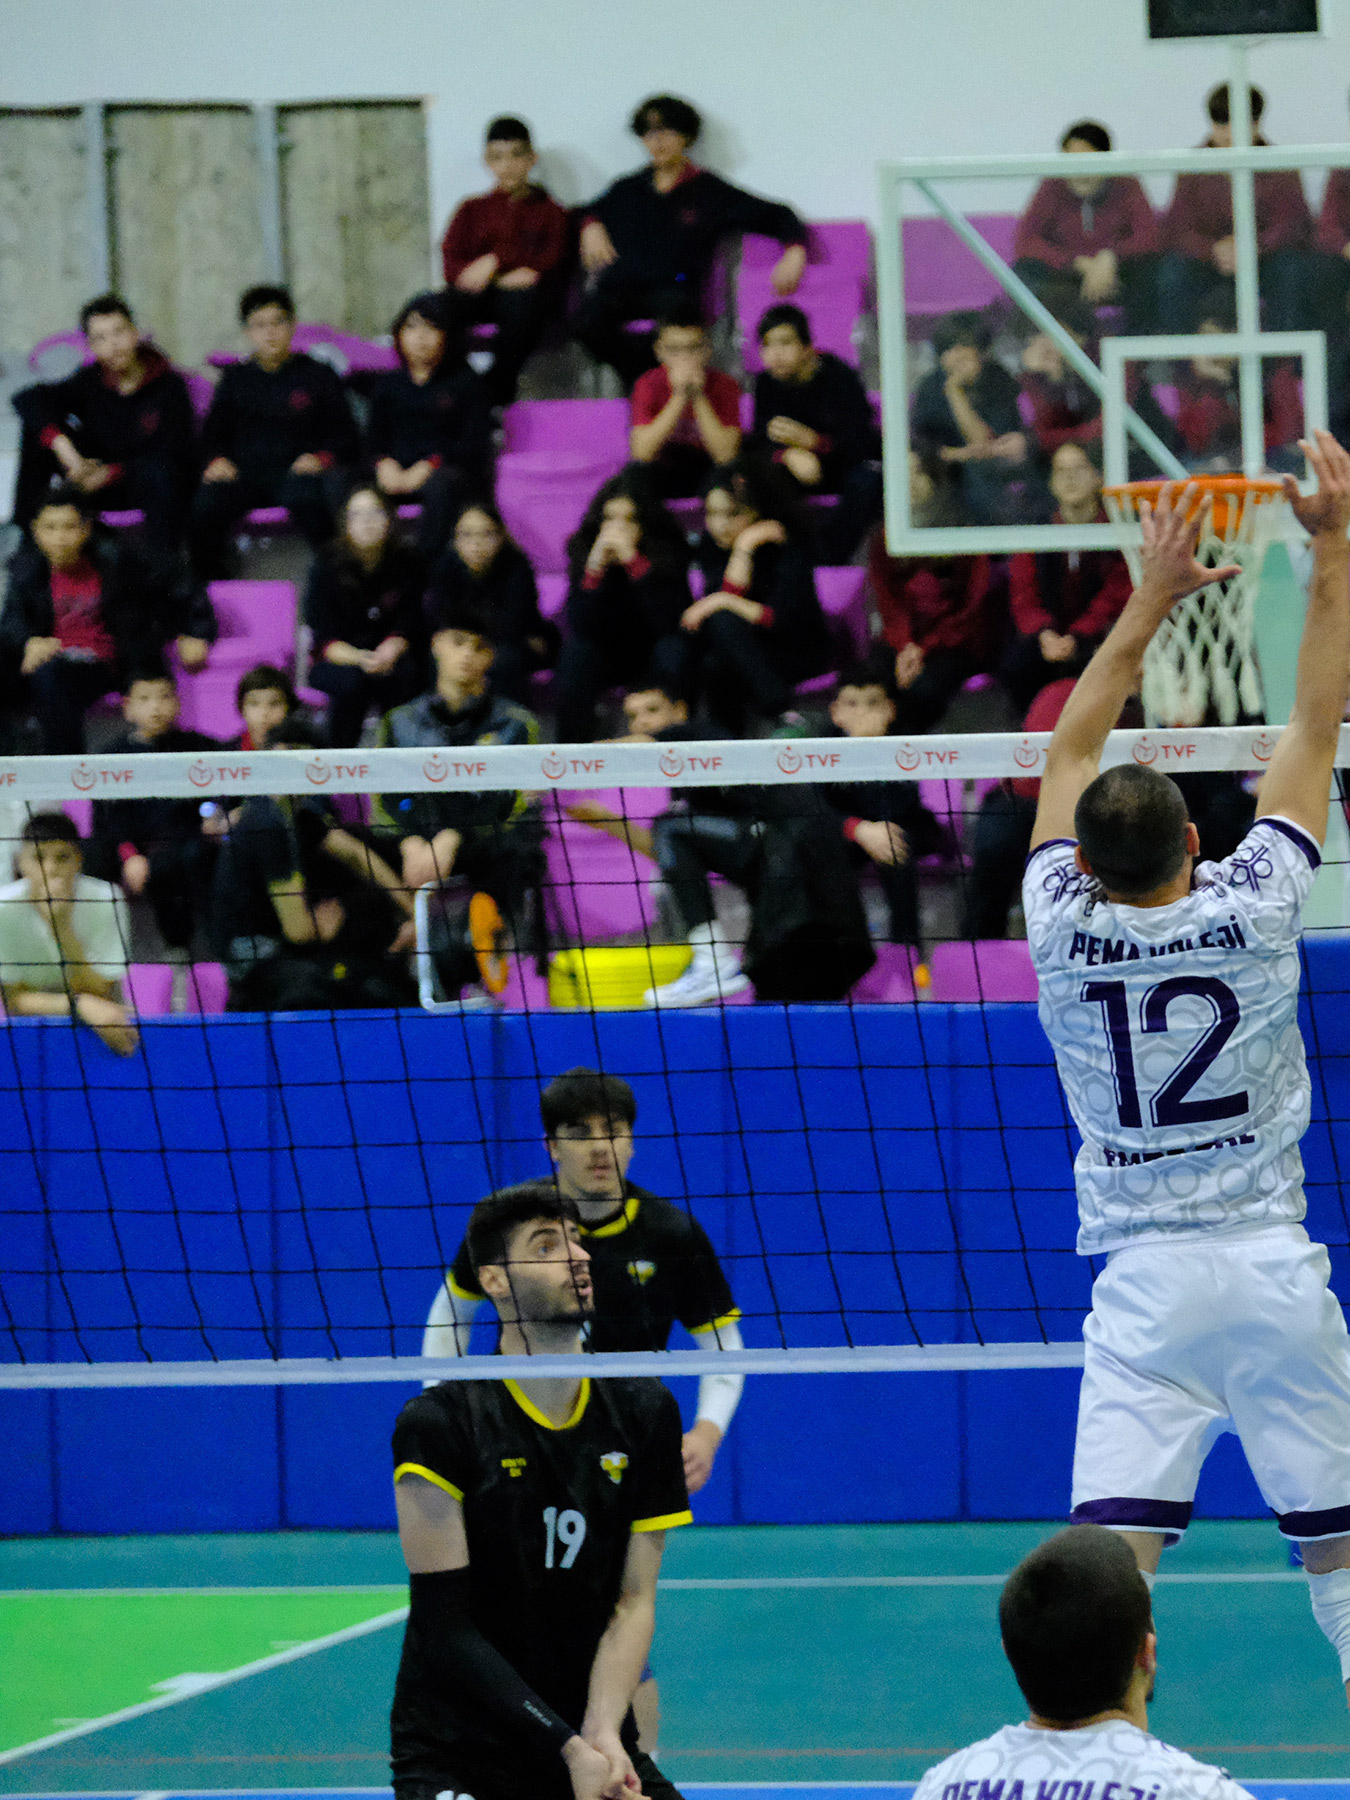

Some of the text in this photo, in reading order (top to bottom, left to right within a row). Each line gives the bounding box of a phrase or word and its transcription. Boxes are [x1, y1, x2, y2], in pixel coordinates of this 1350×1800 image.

[100, 769, 133, 783] TVF
[217, 766, 250, 780] TVF
[335, 764, 368, 778] TVF
[453, 762, 486, 776] TVF
[570, 759, 604, 773] TVF
[687, 756, 722, 771] TVF
[805, 753, 841, 768] TVF
[924, 750, 959, 765] TVF
[1161, 743, 1197, 759] TVF
[1080, 975, 1249, 1128] 12
[543, 1506, 587, 1569] 19
